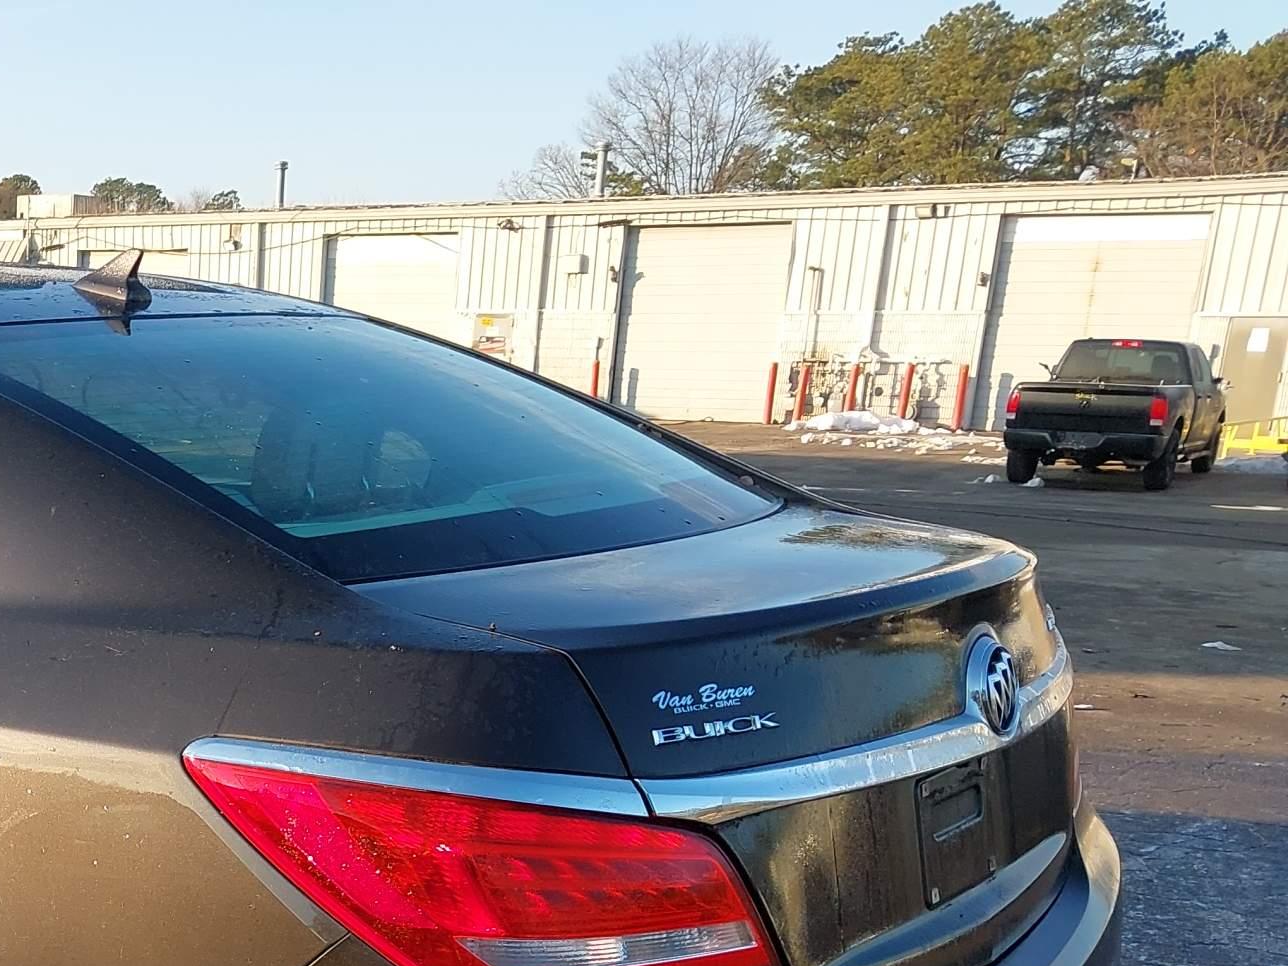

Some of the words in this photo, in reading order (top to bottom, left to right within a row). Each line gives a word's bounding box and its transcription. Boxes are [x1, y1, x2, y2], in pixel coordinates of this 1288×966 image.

[652, 690, 694, 710] Van
[699, 683, 755, 703] Buren
[673, 701, 709, 714] BUICK
[715, 698, 742, 709] GMC
[651, 711, 780, 746] BUICK
